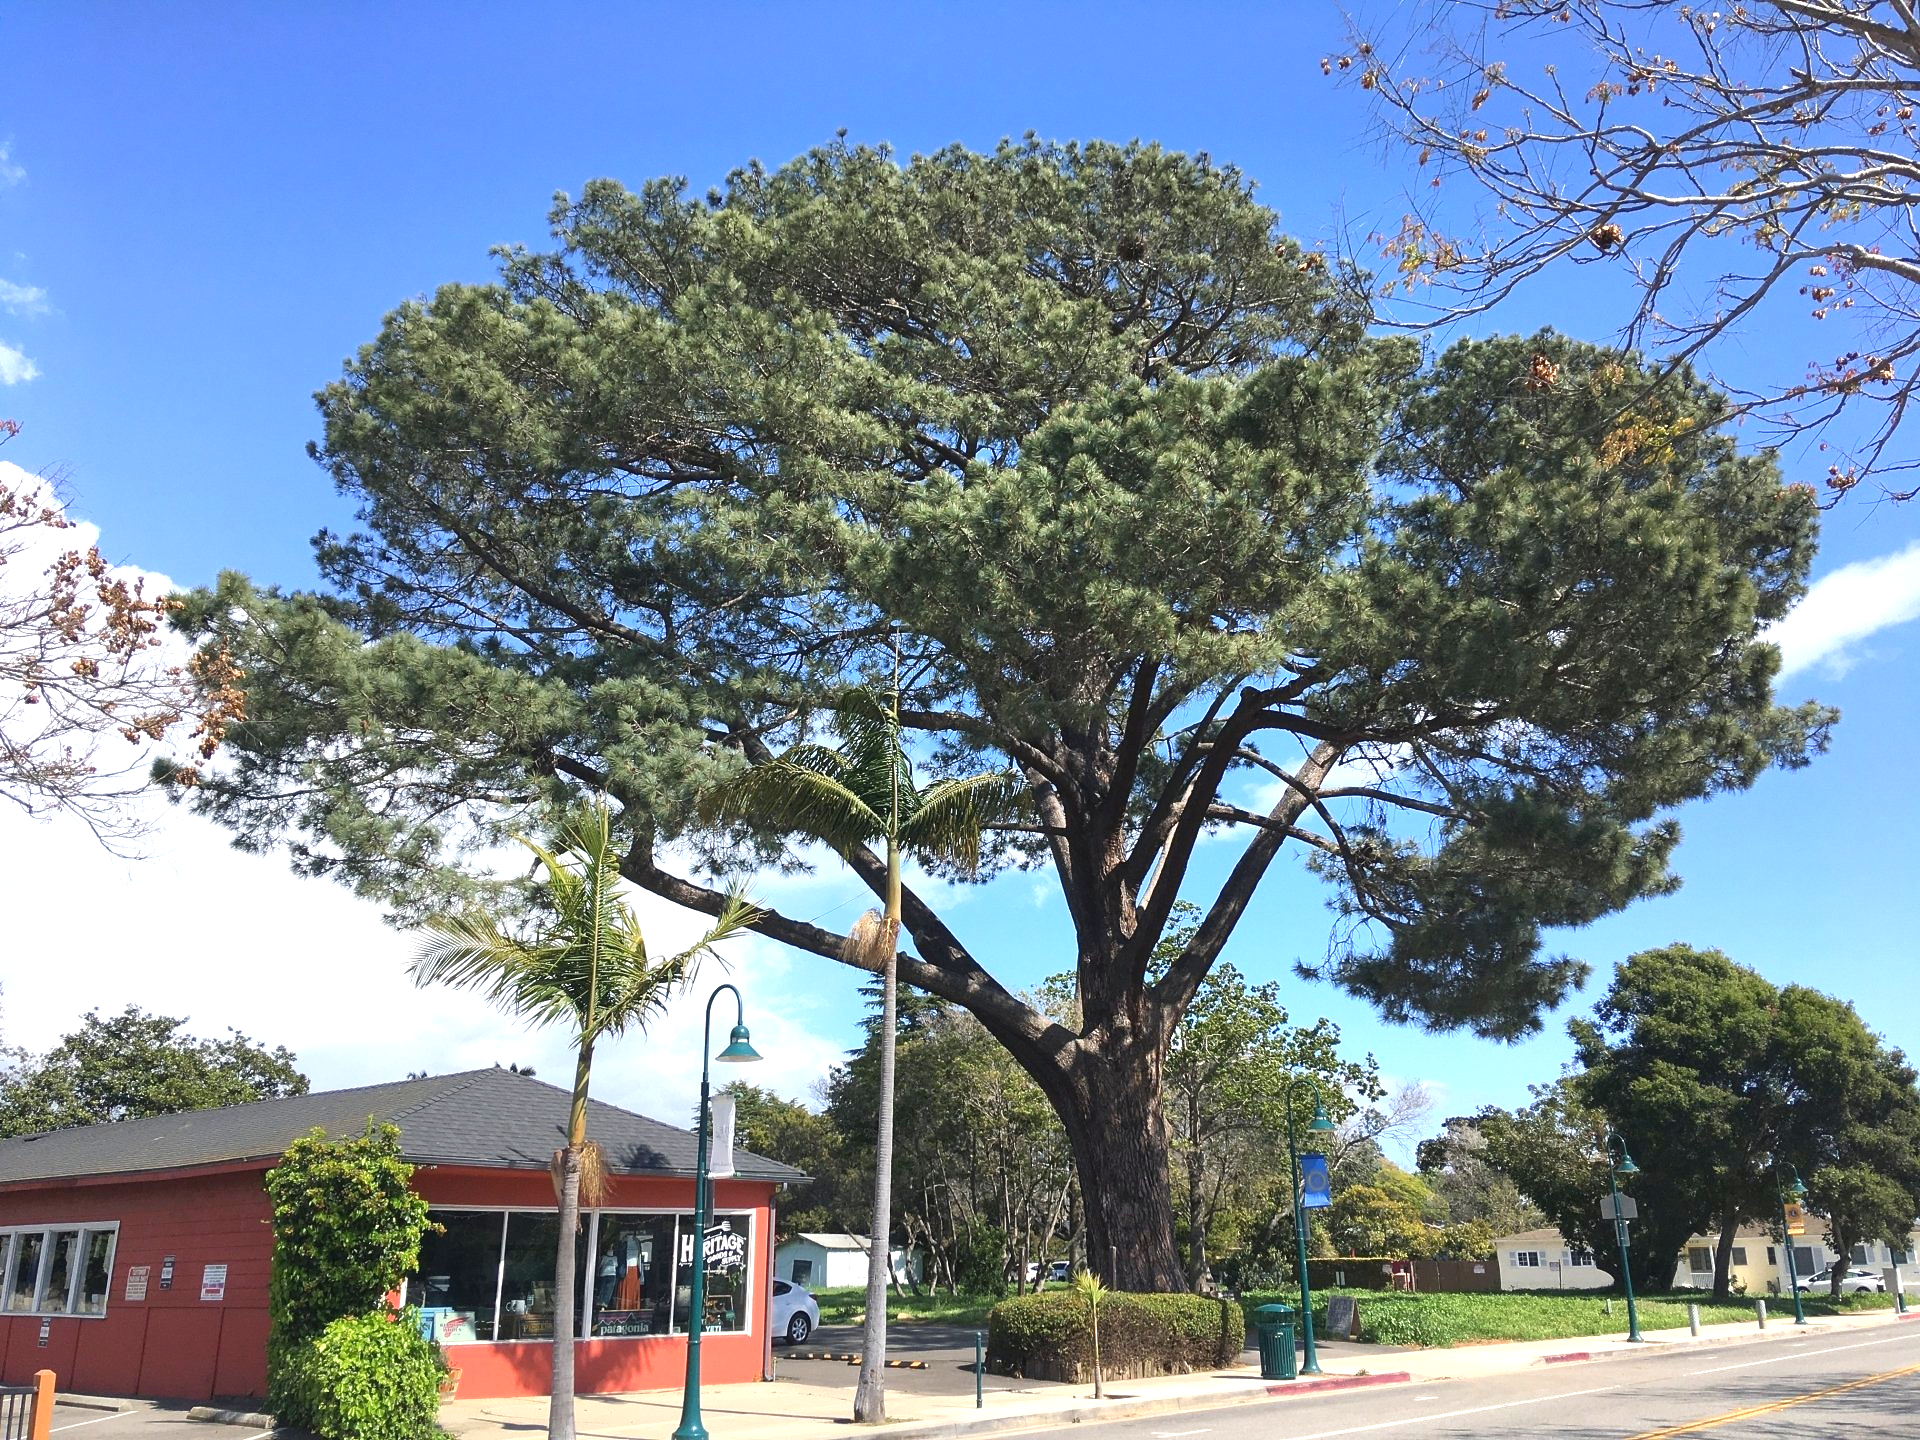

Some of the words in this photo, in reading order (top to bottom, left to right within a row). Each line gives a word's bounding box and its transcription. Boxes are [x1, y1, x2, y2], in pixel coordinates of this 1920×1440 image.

[681, 1234, 744, 1262] HRITAGE
[706, 1252, 728, 1263] GOODS
[721, 1255, 742, 1265] SUPPLY
[600, 1323, 649, 1335] patagonia
[705, 1325, 722, 1333] YETI
